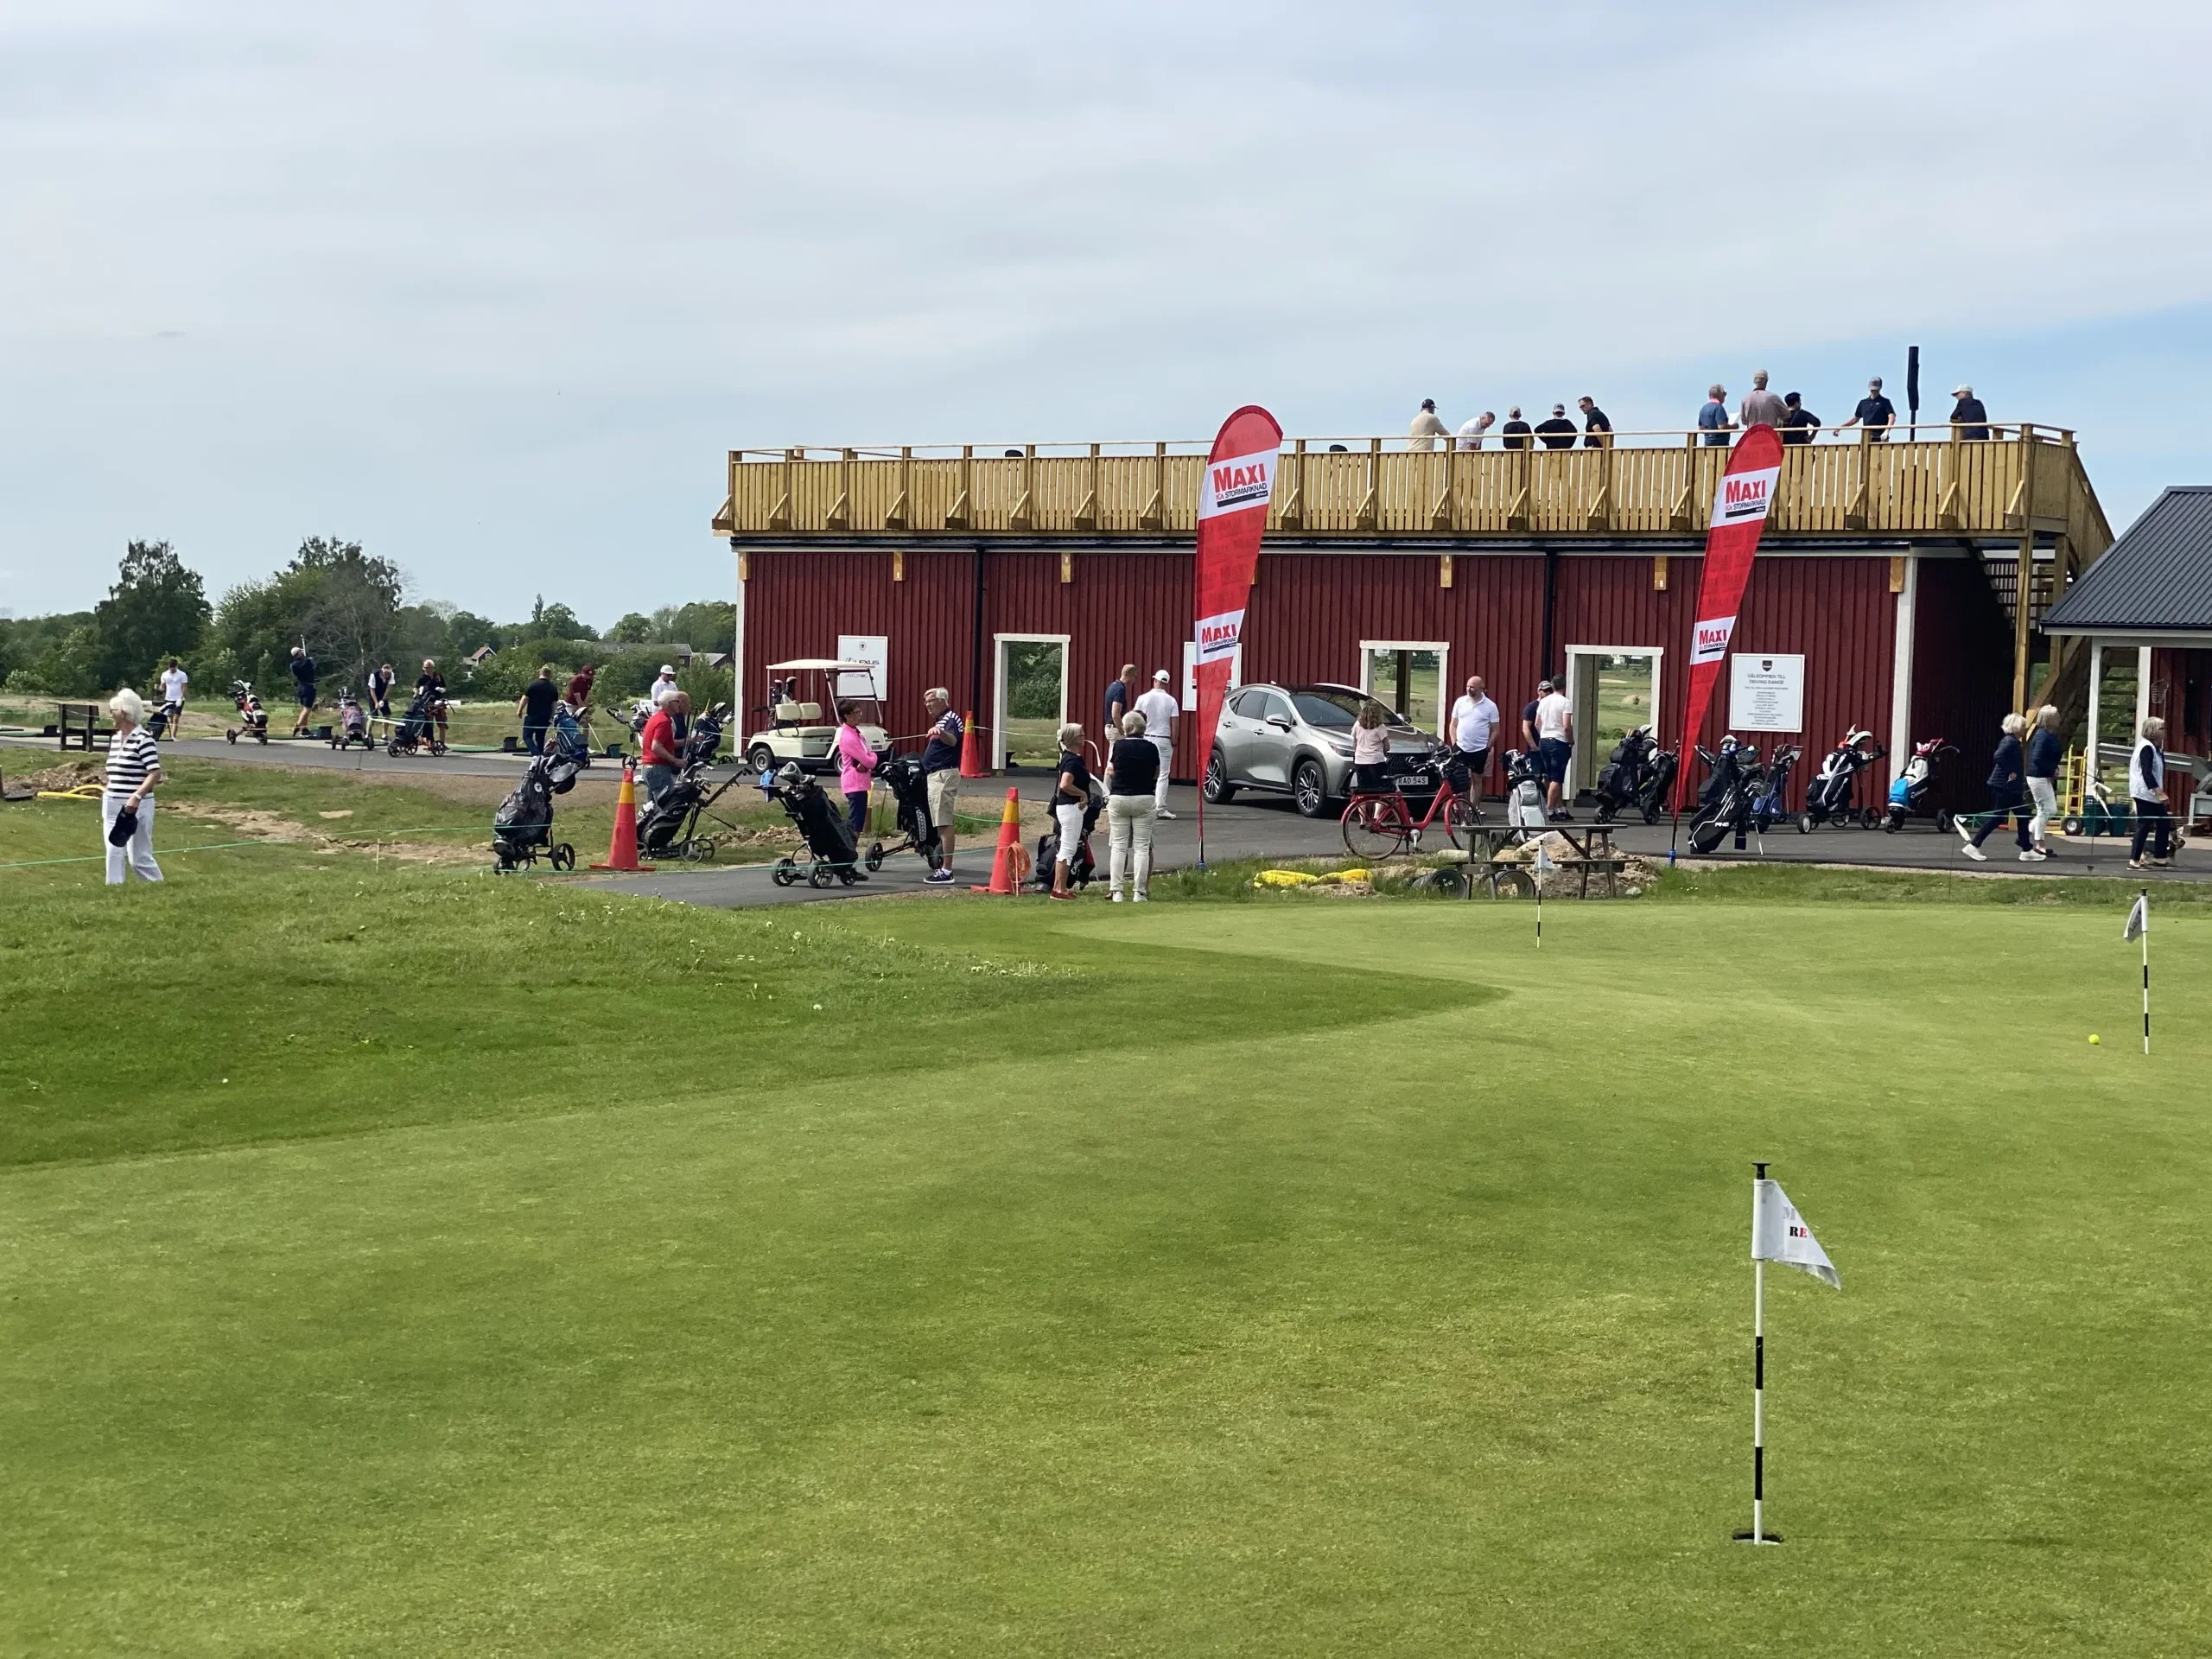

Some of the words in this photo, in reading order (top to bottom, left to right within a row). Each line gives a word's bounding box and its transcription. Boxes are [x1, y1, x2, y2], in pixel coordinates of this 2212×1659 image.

[1213, 463, 1266, 493] MAXI
[1225, 483, 1268, 499] STORMARKNAD
[1726, 480, 1766, 504] MAXI
[1202, 624, 1236, 645] MAXI
[1699, 629, 1727, 645] MAXI
